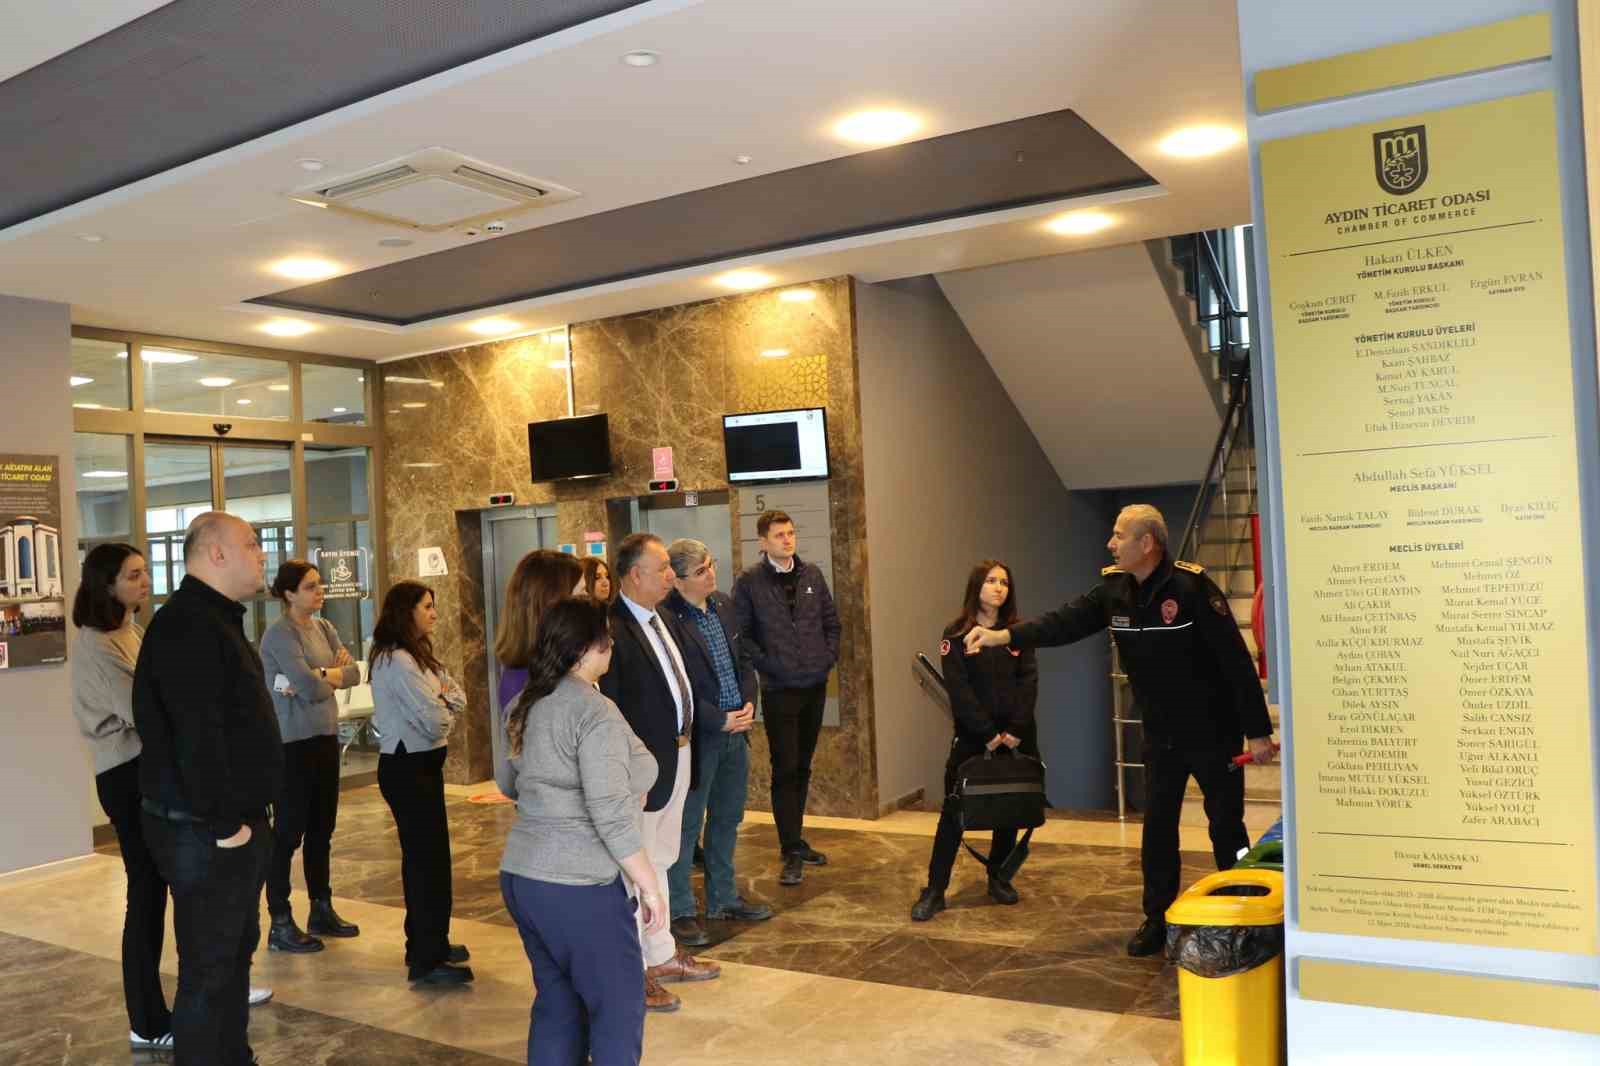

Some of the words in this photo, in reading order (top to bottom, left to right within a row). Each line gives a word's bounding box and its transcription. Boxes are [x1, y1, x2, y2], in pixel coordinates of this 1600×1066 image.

[1324, 207, 1369, 225] AYDIN
[1372, 198, 1437, 218] TİCARET
[1441, 189, 1491, 208] ODASI
[1337, 220, 1389, 235] CHAMBER
[1394, 217, 1408, 227] OF
[1413, 208, 1477, 225] COMMERCE
[1364, 252, 1403, 267] Hakan
[1407, 244, 1454, 262] ÜLKEN
[1356, 266, 1392, 280] YÖNETİM
[1393, 263, 1426, 275] KURULU
[1427, 259, 1464, 271] BAŞKANI
[1470, 276, 1501, 291] Ergün
[1504, 271, 1543, 285] EVRAN
[1412, 283, 1450, 297] ERKUL
[1354, 332, 1394, 345] YÖNETİM
[1396, 328, 1434, 340] KURULU
[1435, 322, 1476, 335] ÜYELERİ
[33, 464, 53, 473] ALAN
[1, 471, 29, 481] TİCARET
[1353, 470, 1407, 484] Abdullah
[1390, 484, 1420, 493] MECLİS
[1421, 481, 1457, 492] BAŞKANI
[756, 494, 766, 512] 5
[1441, 504, 1481, 516] DURAK
[1390, 542, 1422, 553] MECLİS
[1424, 539, 1464, 552] ÜYELERİ
[1363, 561, 1400, 571] ERDEM
[1476, 623, 1507, 633] Kemal
[1363, 675, 1408, 686] ÇEKMEN
[1490, 674, 1531, 684] ERDEM
